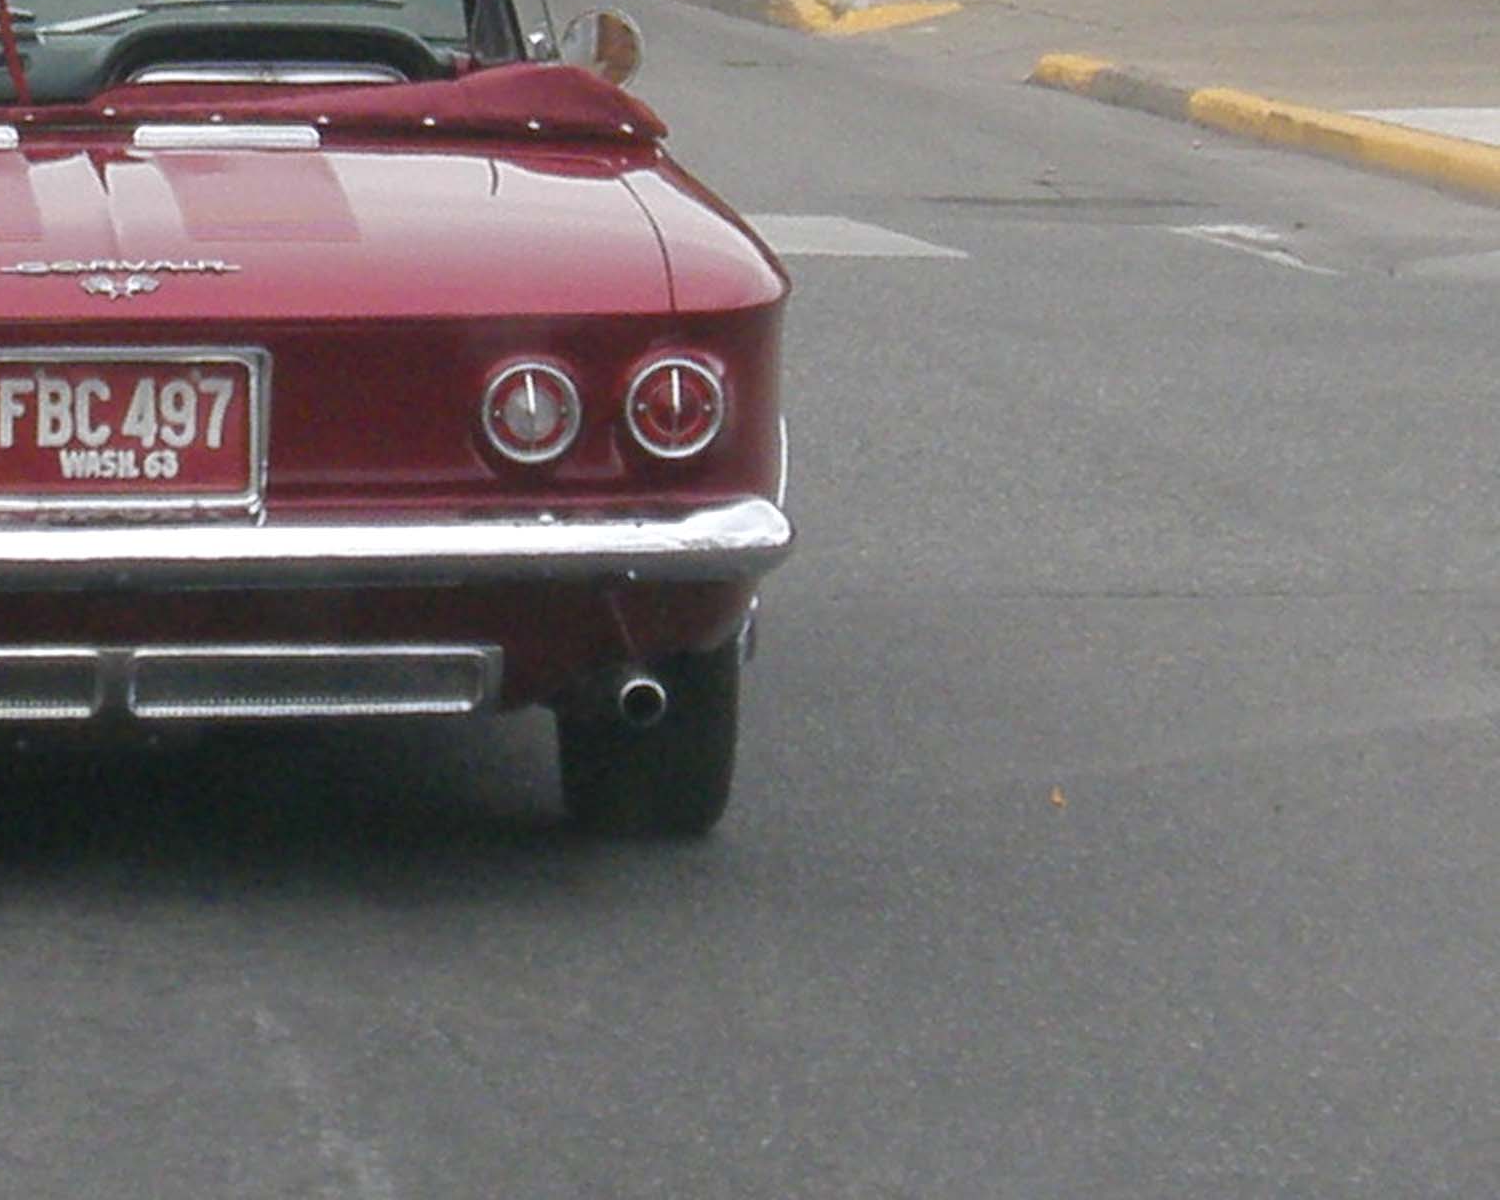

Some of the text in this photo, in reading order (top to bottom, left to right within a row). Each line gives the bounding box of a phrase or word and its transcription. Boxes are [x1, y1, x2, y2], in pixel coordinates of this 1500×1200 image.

[14, 259, 226, 275] CORVAIR
[120, 377, 234, 449] 497
[143, 450, 180, 479] 63
